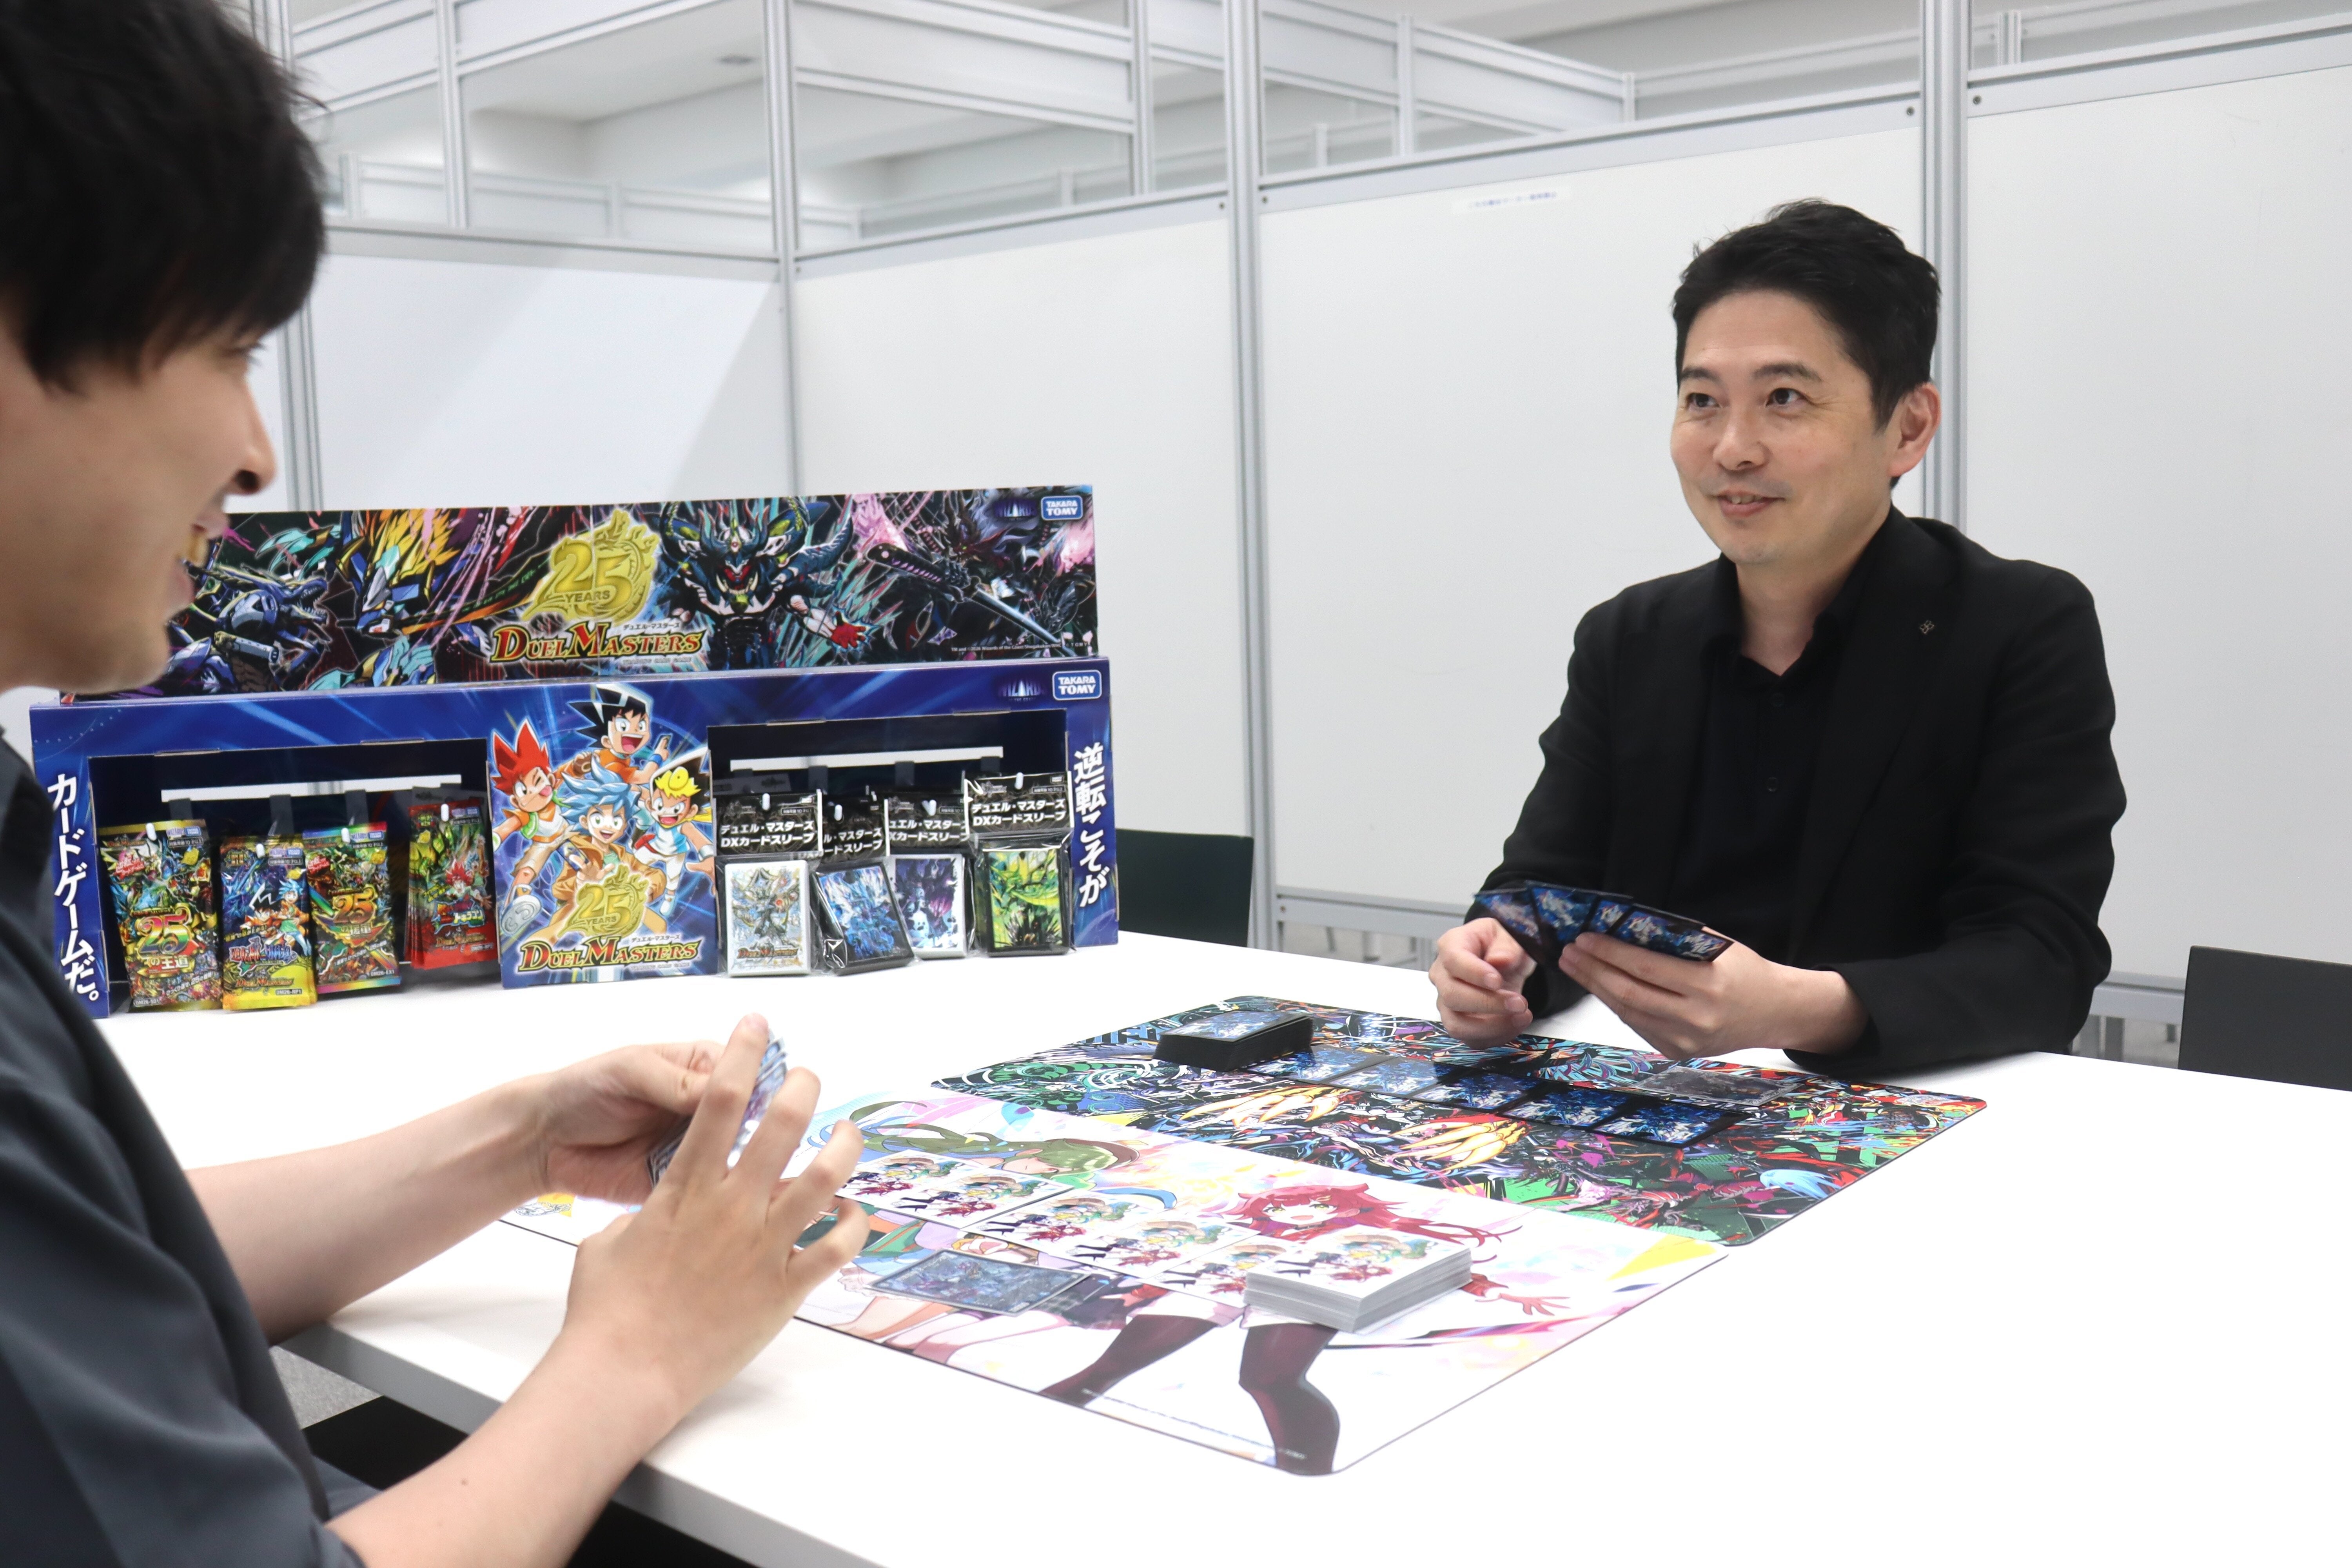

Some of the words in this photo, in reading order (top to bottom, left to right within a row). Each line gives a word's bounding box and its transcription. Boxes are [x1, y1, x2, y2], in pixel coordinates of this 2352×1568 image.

[1046, 507, 1078, 516] TOMY
[550, 540, 633, 610] 25
[565, 590, 610, 603] YEARS
[491, 625, 570, 662] DUEL
[567, 622, 706, 657] MASTERS
[1058, 675, 1096, 685] TAKARA
[1058, 684, 1096, 695] TOMY
[972, 799, 1066, 814] デュエル・マスターズ
[889, 819, 966, 830] ュエル・マスター
[973, 811, 1067, 826] DXカードスリーブ
[1073, 742, 1111, 907] 逆転こそが
[720, 820, 815, 835] デュエル・マスターズ
[823, 827, 882, 843] ル・マスターズ
[720, 832, 815, 848] DXカードスリーブ
[889, 831, 970, 842] Xカードスリーブ
[824, 839, 883, 855] ードスリーブ
[47, 773, 99, 1001] カードゲームだ。
[333, 885, 376, 924] 25
[577, 885, 632, 930] 25
[586, 916, 617, 925] YEARS
[137, 905, 192, 957] 25
[518, 941, 586, 972] DUEL
[583, 936, 702, 967] MASTERS
[151, 956, 189, 970] の王道
